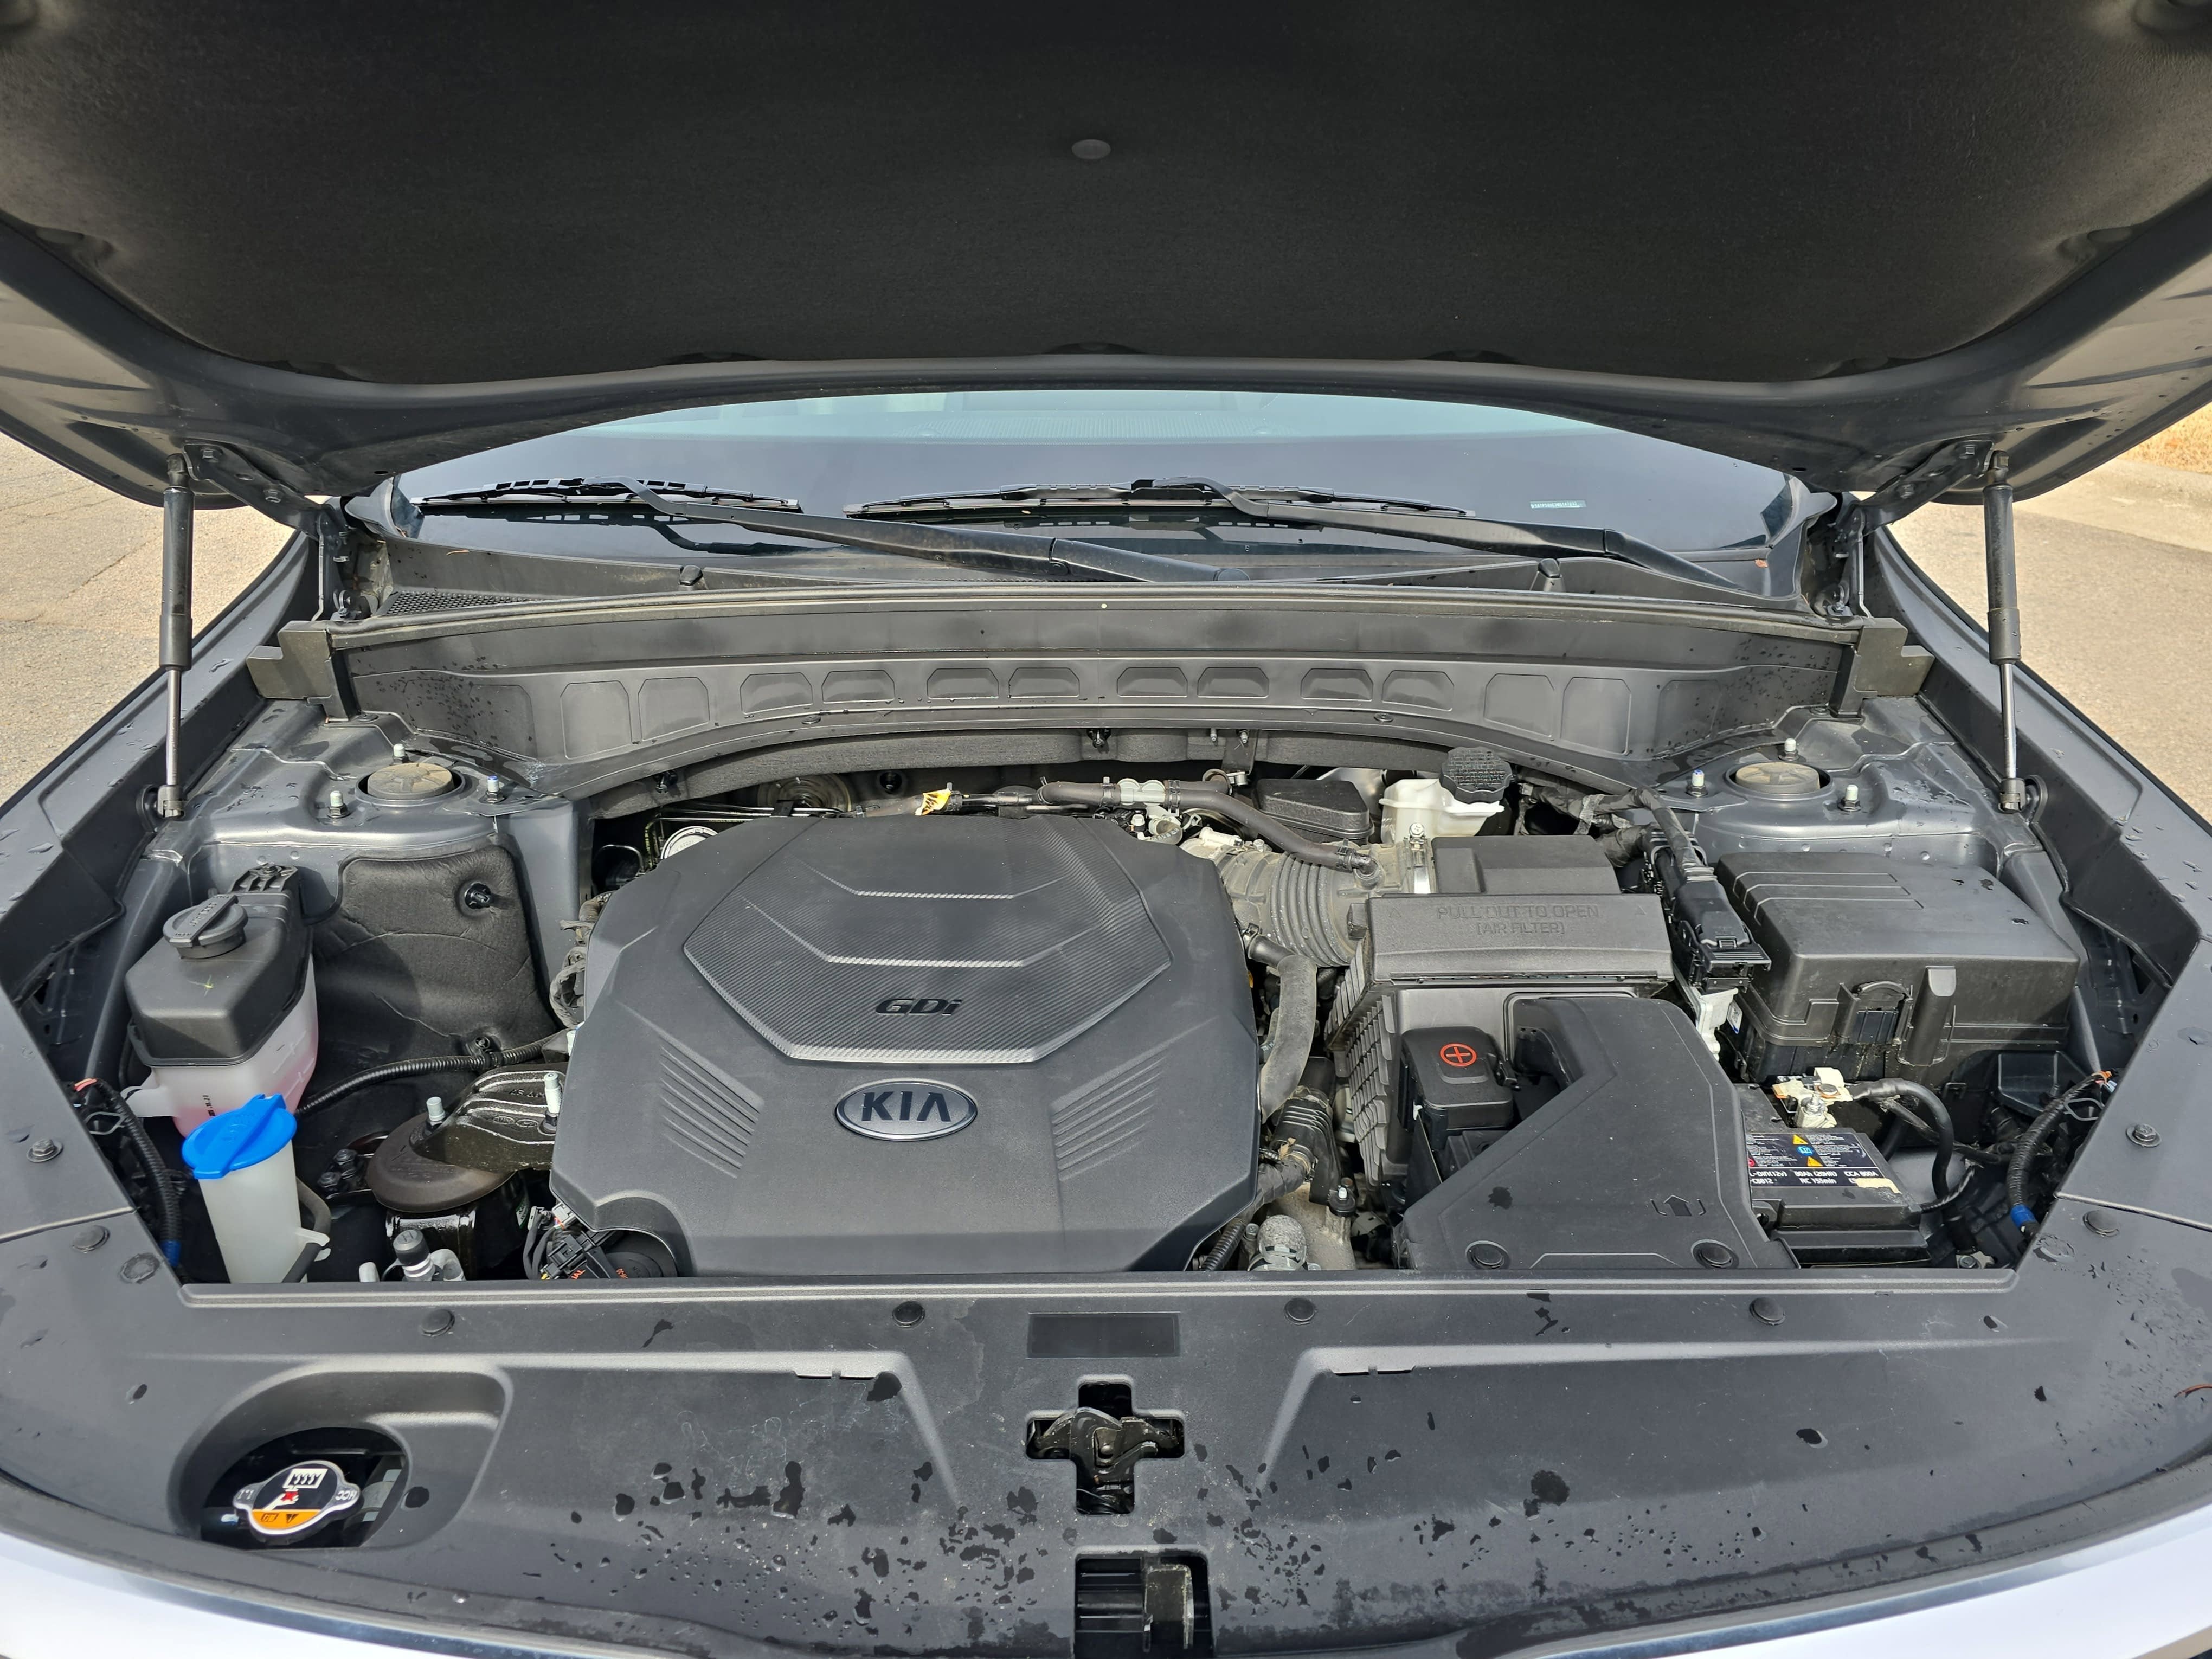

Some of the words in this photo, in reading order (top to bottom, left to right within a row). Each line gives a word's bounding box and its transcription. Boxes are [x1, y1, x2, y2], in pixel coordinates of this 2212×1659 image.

[1437, 906, 1482, 919] PULL
[1487, 905, 1519, 919] OUT
[1526, 905, 1548, 918] TO
[1553, 905, 1599, 918] OPEN
[876, 998, 963, 1015] GDi
[861, 1091, 951, 1122] KIA
[335, 1490, 357, 1501] HCC
